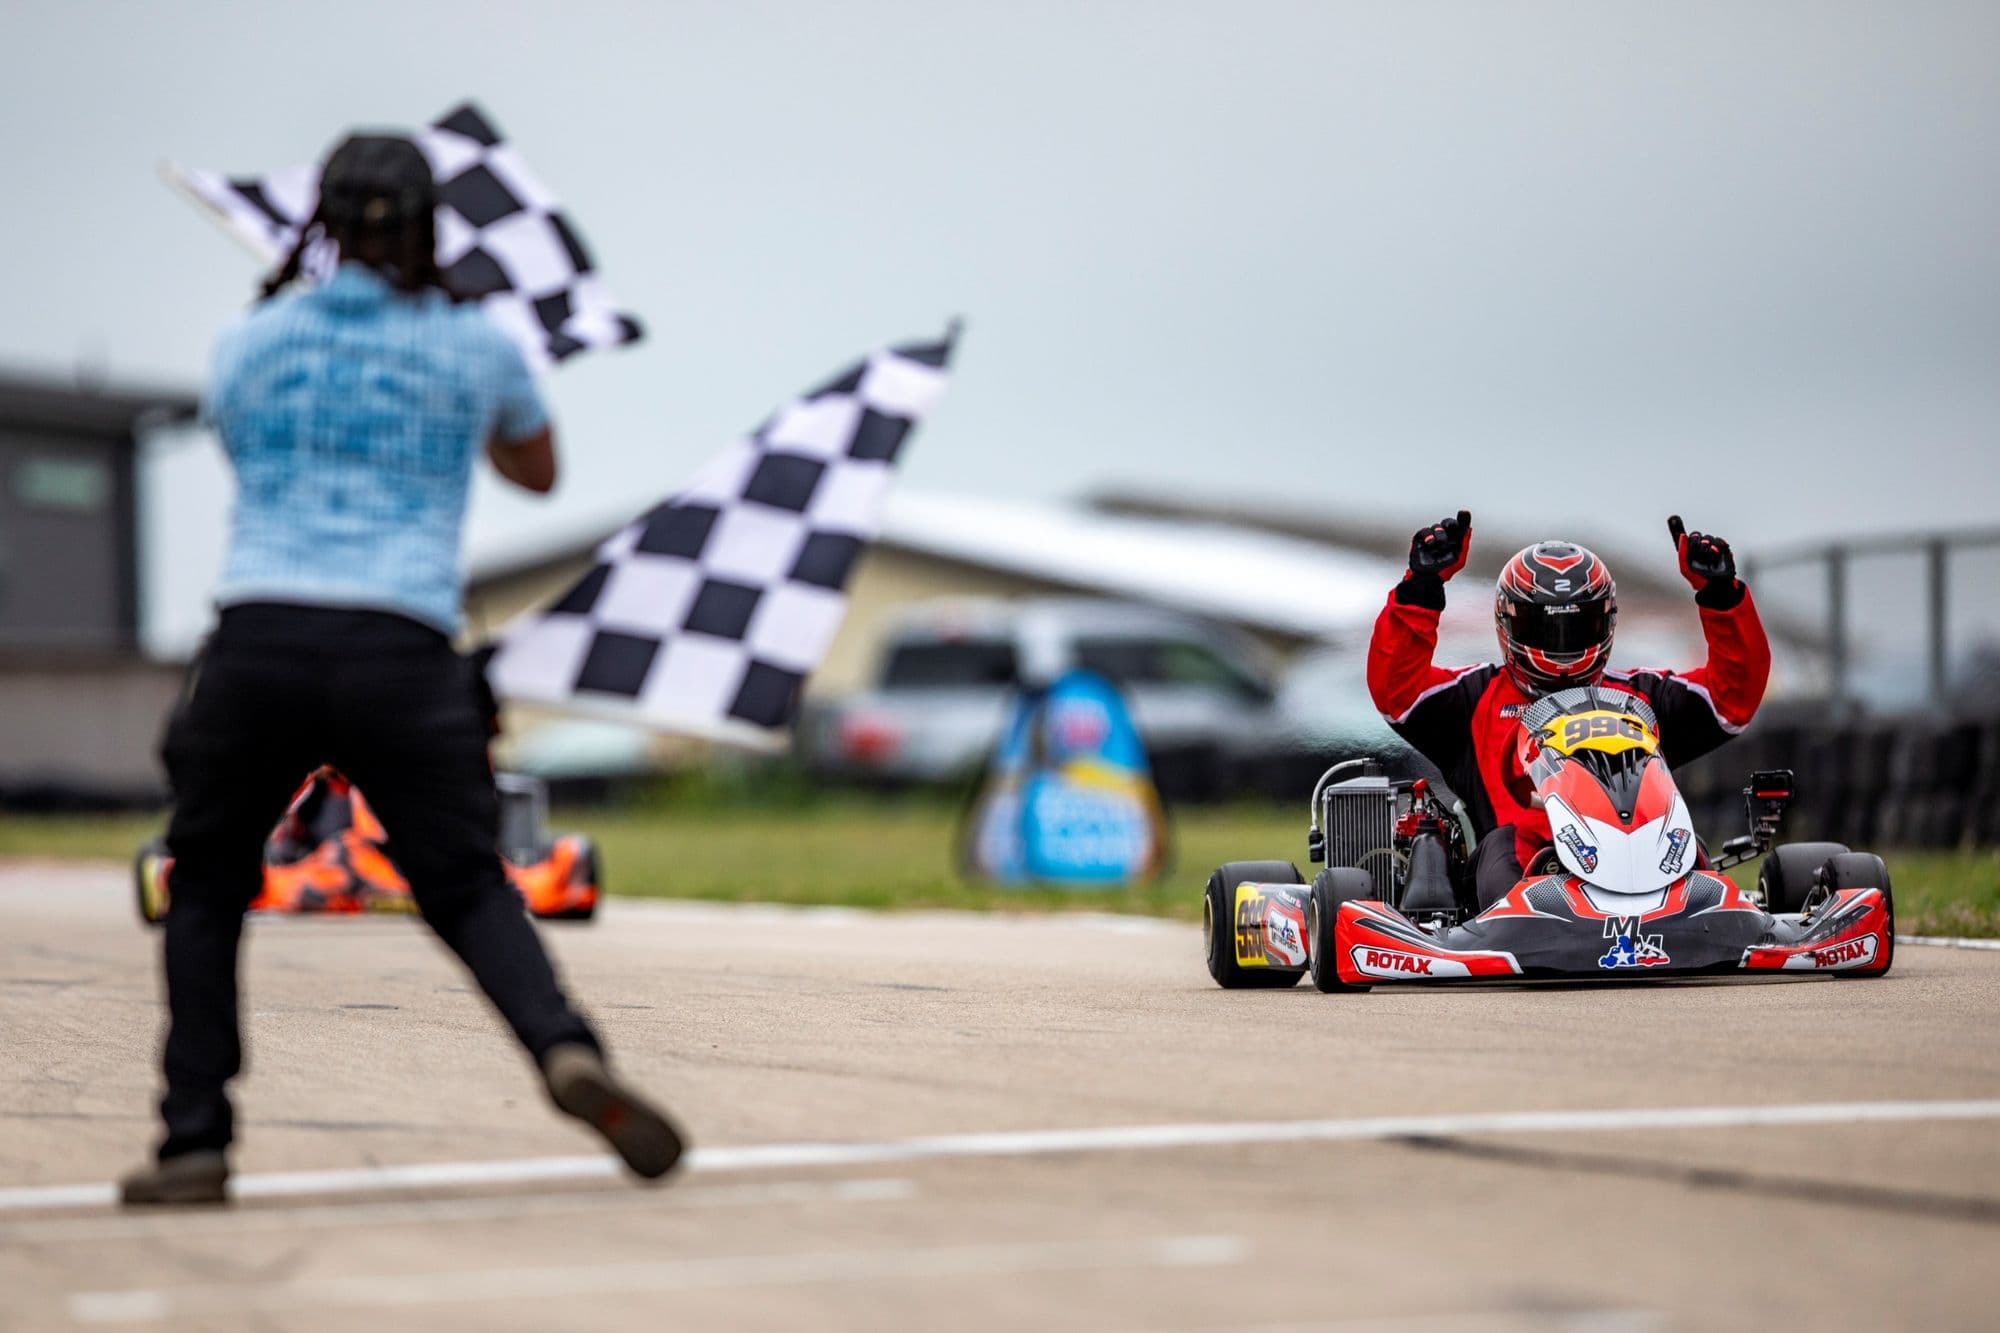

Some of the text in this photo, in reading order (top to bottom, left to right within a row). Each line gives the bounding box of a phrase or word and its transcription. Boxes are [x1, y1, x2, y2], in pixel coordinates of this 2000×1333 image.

[1565, 716, 1644, 748] 996
[1366, 950, 1432, 975] ROTAX
[1814, 940, 1866, 968] ROTAX
